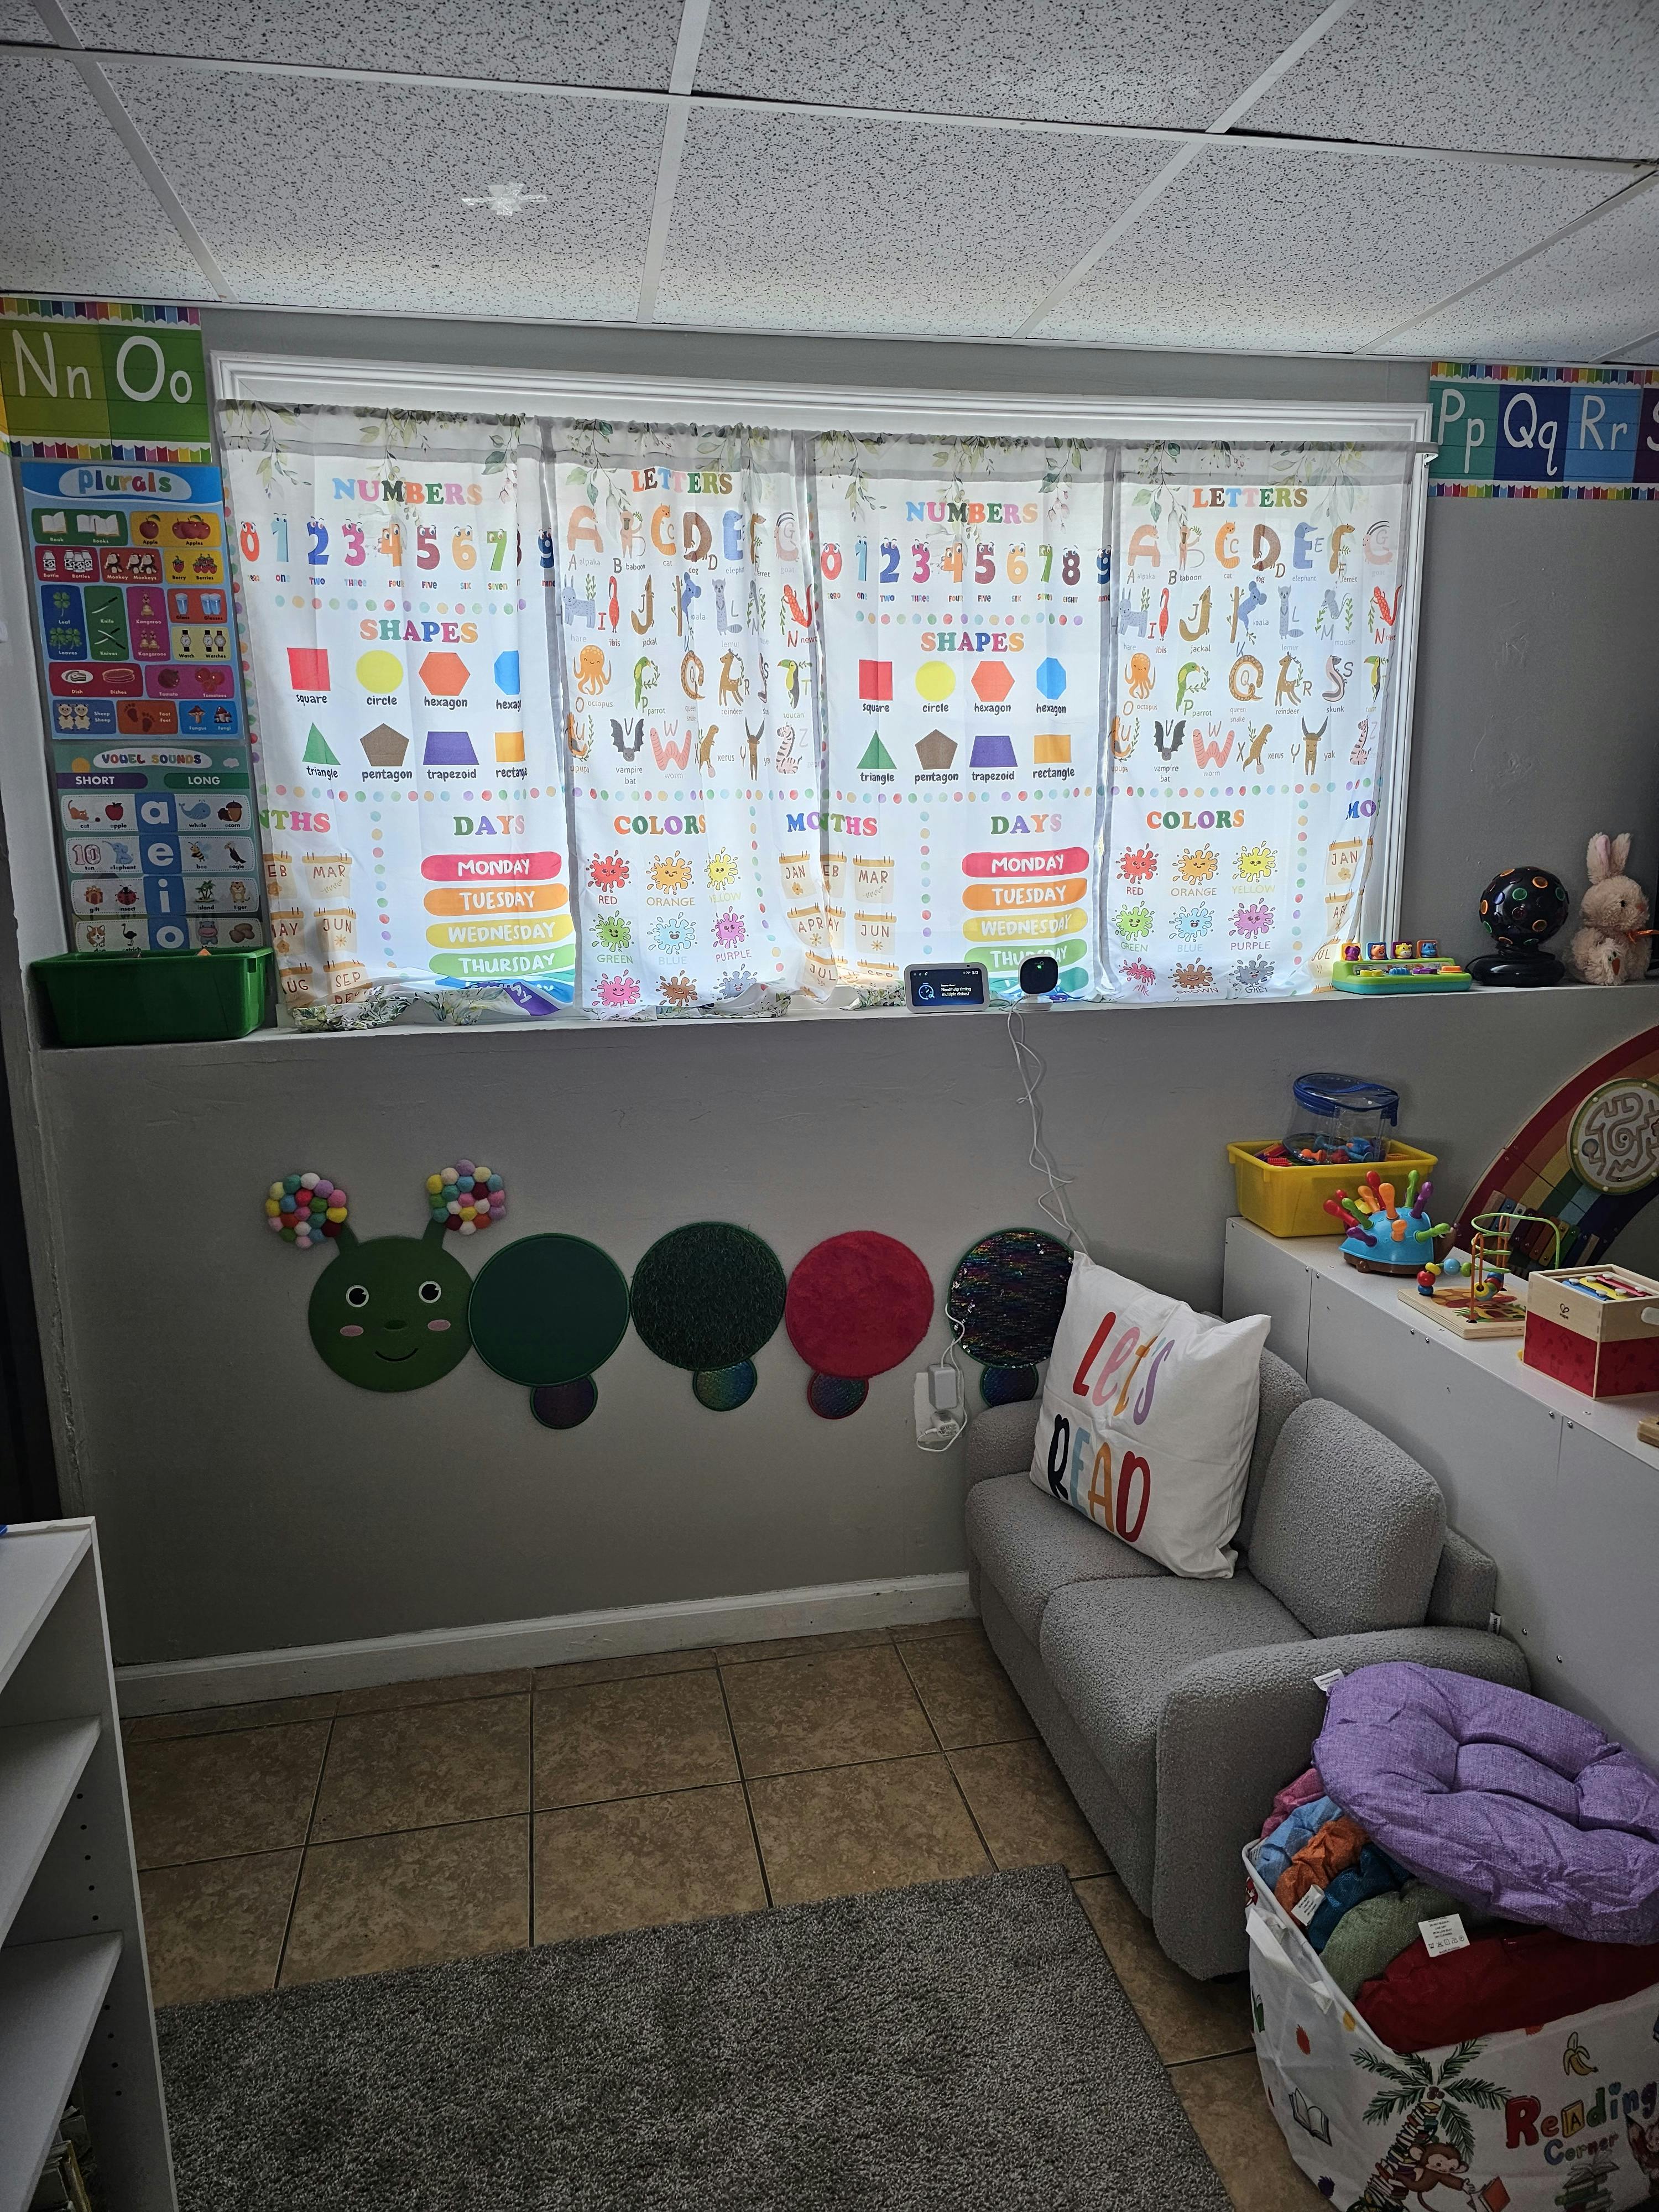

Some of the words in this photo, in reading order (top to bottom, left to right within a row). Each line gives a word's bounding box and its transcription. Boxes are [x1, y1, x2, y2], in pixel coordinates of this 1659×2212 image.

[630, 467, 733, 495] LETTERS
[333, 478, 483, 505] NUMBERS
[1192, 487, 1308, 508] LETTERS
[905, 500, 1039, 525] NUMBERS
[821, 542, 842, 581] 0
[855, 538, 868, 582] 1
[879, 540, 900, 583] 2
[911, 542, 931, 584] 3
[943, 542, 964, 583] 4
[974, 544, 996, 585] 5
[1006, 545, 1029, 585] 6
[1039, 545, 1053, 583] 7
[1062, 550, 1081, 586] 8
[309, 577, 325, 586] TWO
[1137, 572, 1155, 581] alpaka
[1180, 573, 1202, 582] baboon
[1255, 575, 1265, 584] dog
[1292, 574, 1317, 584] elephant
[1253, 618, 1269, 627] koala
[359, 619, 478, 643] SHAPES
[921, 632, 1025, 653] SHAPES
[1334, 638, 1357, 646] mouse
[1191, 644, 1211, 654] jackal
[296, 693, 328, 705] square
[366, 696, 397, 706] circle
[424, 696, 467, 710] hexagon
[587, 700, 613, 708] octopus
[648, 706, 666, 714] parrot
[862, 703, 890, 714] square
[922, 702, 949, 713] circle
[974, 703, 1011, 716] hexagon
[1036, 703, 1067, 716] hexagon
[1136, 703, 1158, 711] octopus
[1192, 709, 1212, 718] parrot
[1230, 707, 1246, 715] queen
[152, 754, 202, 764] SOUNDS
[1324, 750, 1335, 760] yak
[306, 765, 338, 779] triangle
[1032, 767, 1074, 780] rectangle
[1154, 764, 1179, 773] vampire
[76, 776, 114, 785] SHORT
[188, 776, 221, 785] LONG
[362, 769, 413, 782] pentagon
[427, 769, 477, 782] trapezoid
[860, 771, 895, 784] triangle
[914, 772, 959, 785] pentagon
[972, 771, 1015, 784] trapezoid
[1160, 775, 1170, 783] bat
[141, 801, 170, 825] a
[1146, 809, 1245, 830] COLORS
[454, 815, 525, 836] DAYS
[614, 814, 706, 836] COLORS
[990, 813, 1062, 835] DAYS
[148, 842, 174, 867] e
[1331, 851, 1359, 865] JAN
[457, 858, 530, 877] MONDAY
[991, 854, 1065, 873] MONDAY
[312, 865, 346, 879] MAR
[785, 864, 806, 880] JAN
[158, 878, 170, 914] i
[992, 886, 1067, 905] TUESDAY
[1126, 886, 1144, 895] RED
[1171, 887, 1217, 896] ORANGE
[1232, 885, 1275, 894] YELLOW
[459, 890, 535, 911] TUESDAY
[598, 895, 618, 905] RED
[646, 897, 696, 906] ORANGE
[323, 917, 352, 934] JUN
[981, 914, 1072, 936] WEDNESDAY
[448, 921, 556, 943] WEDNESDAY
[1120, 942, 1149, 952] GREEN
[1177, 943, 1203, 952] BLUE
[1230, 941, 1271, 951] PURPLE
[597, 954, 633, 964] GREEN
[716, 949, 753, 963] PURPLE
[458, 953, 556, 974] THURSDAY
[335, 972, 361, 988] SEP
[1047, 1413, 1151, 1542] READ
[1544, 2132, 1619, 2166] Corner
